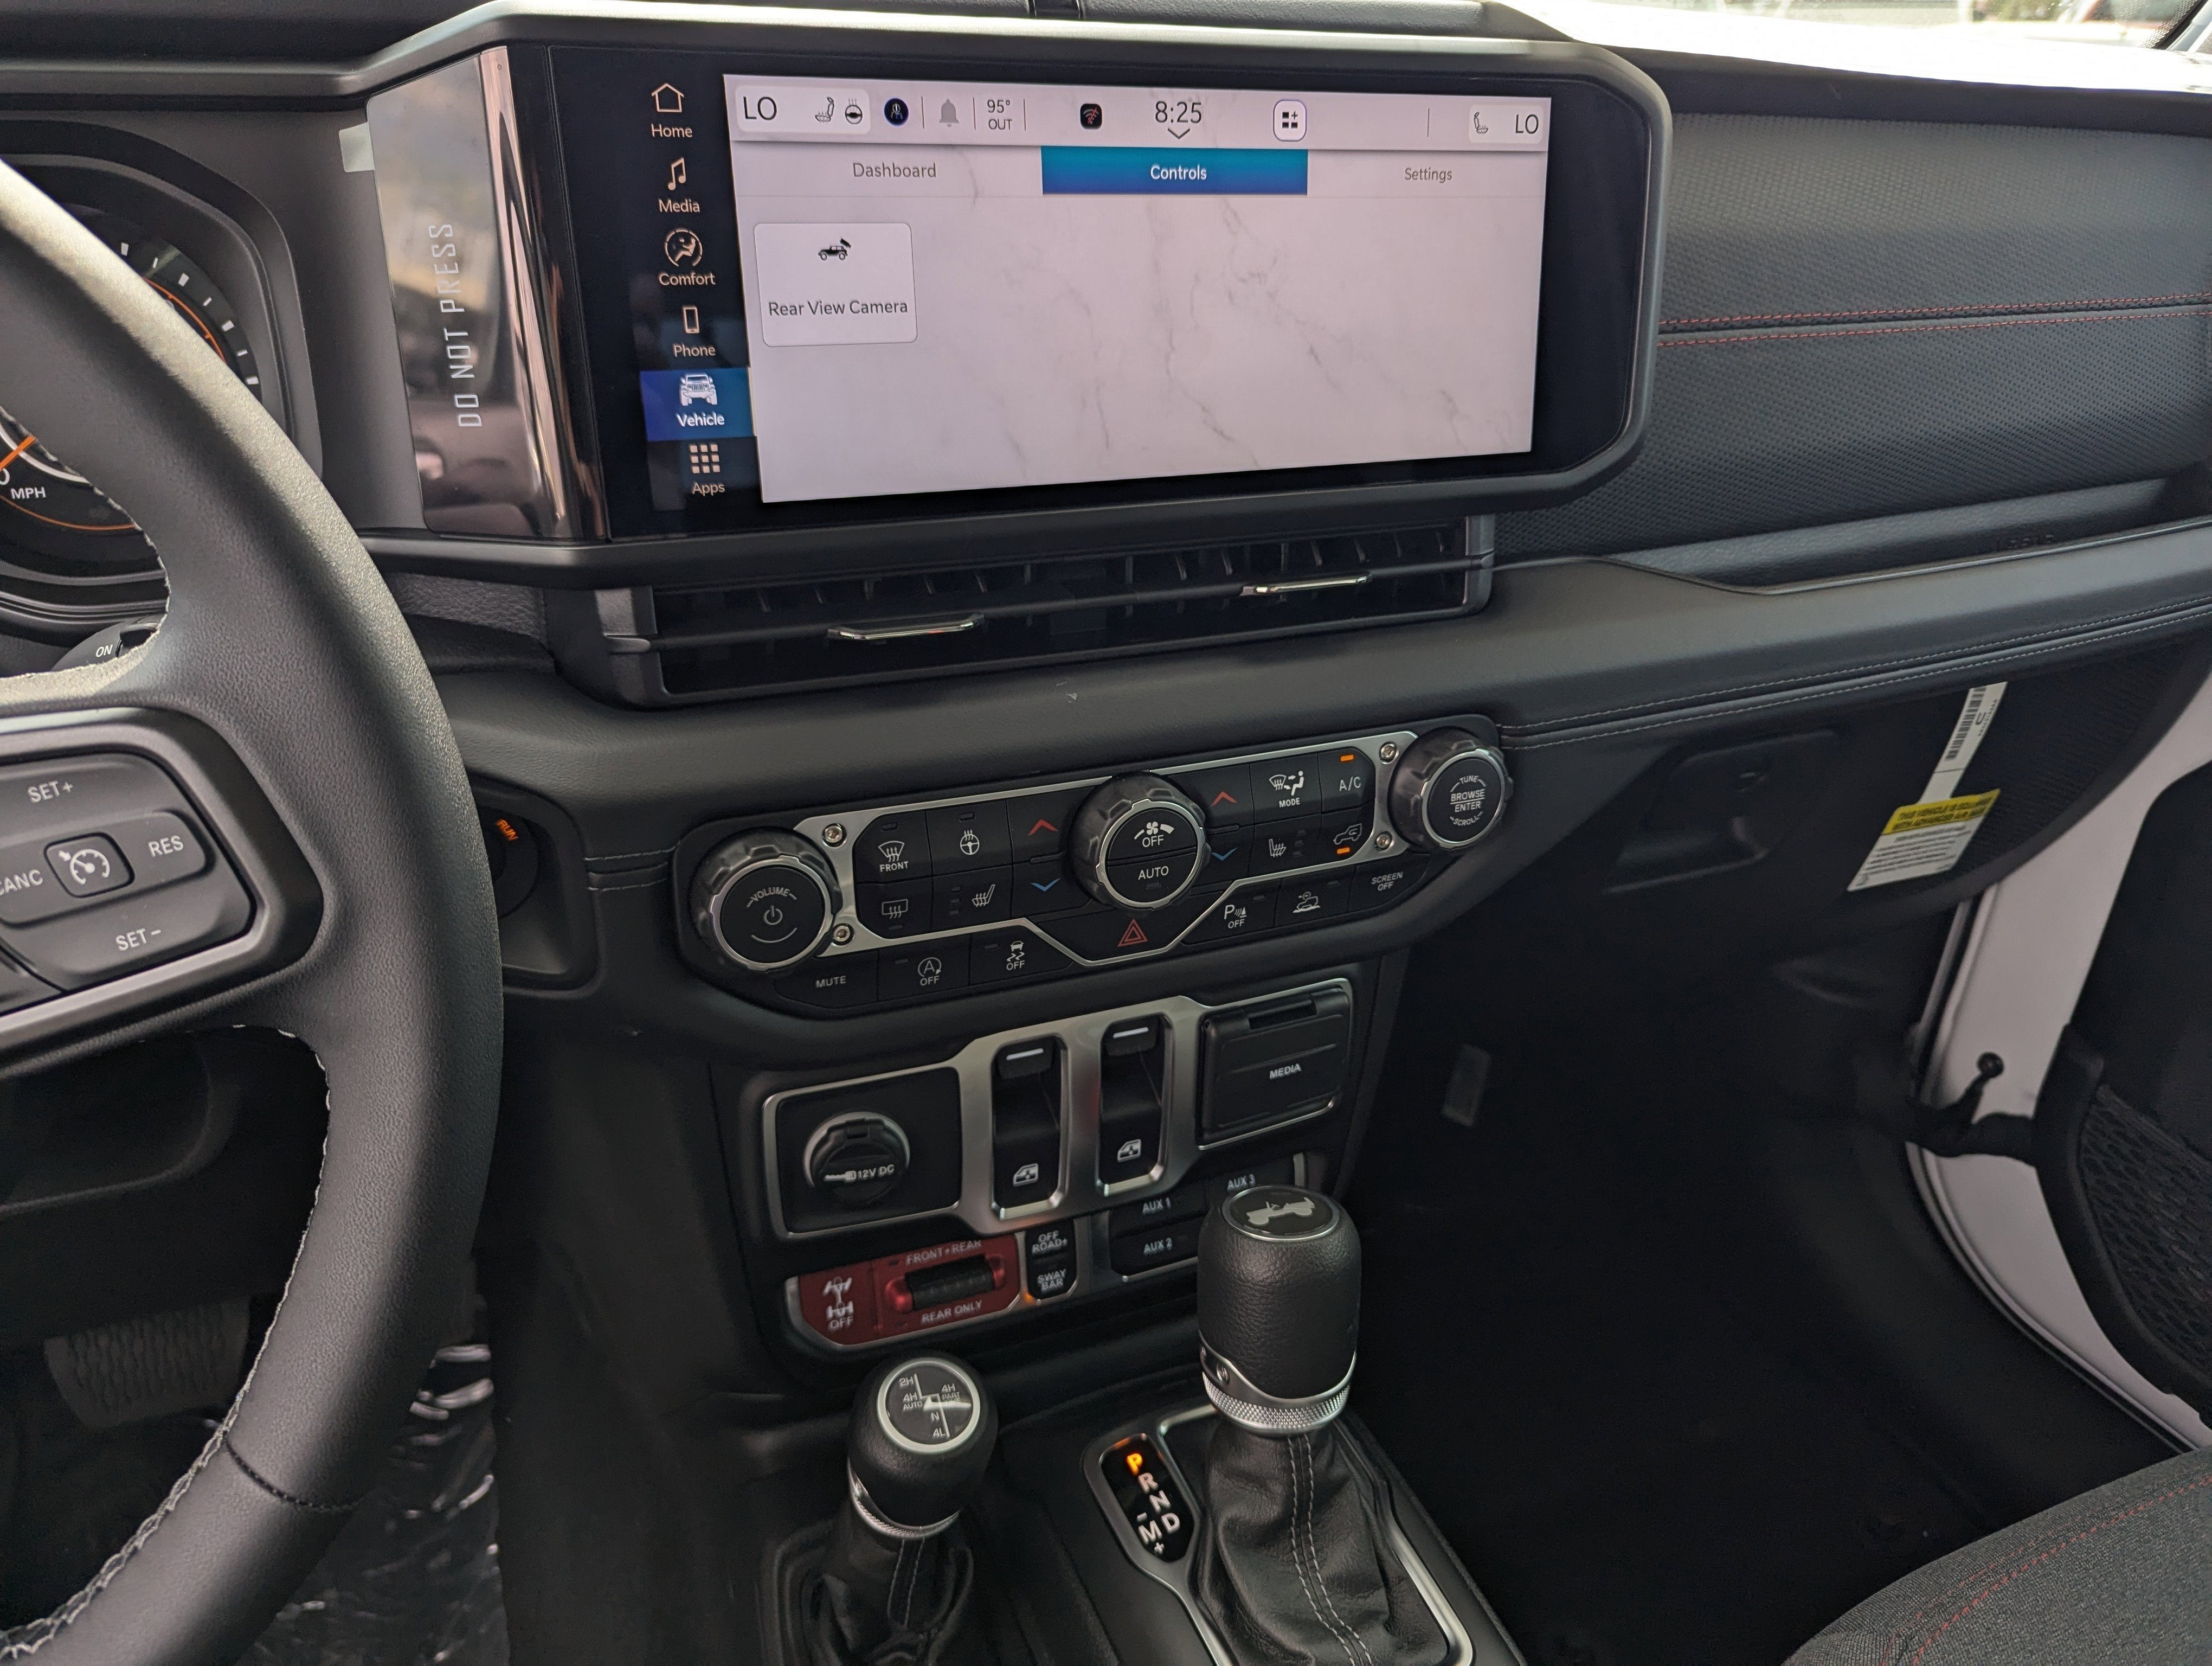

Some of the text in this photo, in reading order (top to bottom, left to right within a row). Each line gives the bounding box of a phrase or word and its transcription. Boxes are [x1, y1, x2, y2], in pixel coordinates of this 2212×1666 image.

[743, 97, 777, 121] LO
[1154, 100, 1203, 124] 8:25
[988, 118, 1013, 131] OUT
[1515, 113, 1539, 134] LO
[651, 124, 693, 138] Home
[852, 162, 937, 178] Dashboard
[1150, 165, 1207, 181] Controls
[1404, 166, 1452, 183] Settings
[659, 200, 700, 213] Media
[659, 272, 716, 286] Comfort
[768, 299, 908, 317] Rear View Camera
[429, 224, 482, 427] DO NOT PRESS
[673, 343, 716, 356] Phone
[676, 412, 725, 427] Vehicle
[11, 487, 46, 499] MPH
[691, 481, 725, 496] Apps
[96, 644, 113, 657] ON
[1339, 775, 1362, 792] A/C
[1459, 775, 1479, 784] TUNE
[27, 781, 74, 803] SET+
[1451, 789, 1485, 802] BROWSE
[1278, 797, 1301, 809] MODE
[1455, 801, 1481, 812] ENTER
[1453, 815, 1480, 826] SCROLL
[496, 819, 519, 841] RUN
[148, 835, 184, 857] RES
[1142, 834, 1165, 849] OFF
[879, 860, 909, 873] FRONT
[1137, 865, 1169, 881] AUTO
[1371, 871, 1404, 886] SCREEN
[1377, 880, 1394, 892] OFF
[750, 887, 790, 902] VOLUME
[1227, 917, 1245, 930] OFF
[1006, 959, 1025, 971] OFF
[815, 975, 847, 988] MUTE
[919, 975, 940, 986] OFF
[1269, 1063, 1301, 1080] MEDIA
[858, 1164, 895, 1178] 12V DC
[1227, 1176, 1247, 1190] AUX
[1142, 1198, 1172, 1214] AUX 1
[1038, 1230, 1059, 1243] OFF
[1143, 1238, 1173, 1255] AUX 2
[1037, 1268, 1066, 1284] SWAY
[1041, 1278, 1064, 1292] BAR
[922, 1300, 982, 1323] REAR ONLY
[828, 1315, 854, 1331] OFF
[899, 1376, 915, 1387] 2H
[941, 1383, 956, 1393] 4H
[903, 1392, 918, 1402] 4H
[942, 1392, 961, 1400] PART
[902, 1401, 923, 1411] AUTO
[931, 1411, 940, 1421] N
[933, 1427, 946, 1438] 4L
[1126, 1453, 1143, 1476] P
[1138, 1472, 1159, 1494] R
[1149, 1490, 1171, 1514] N
[1161, 1513, 1181, 1534] D
[1138, 1520, 1163, 1545] M
